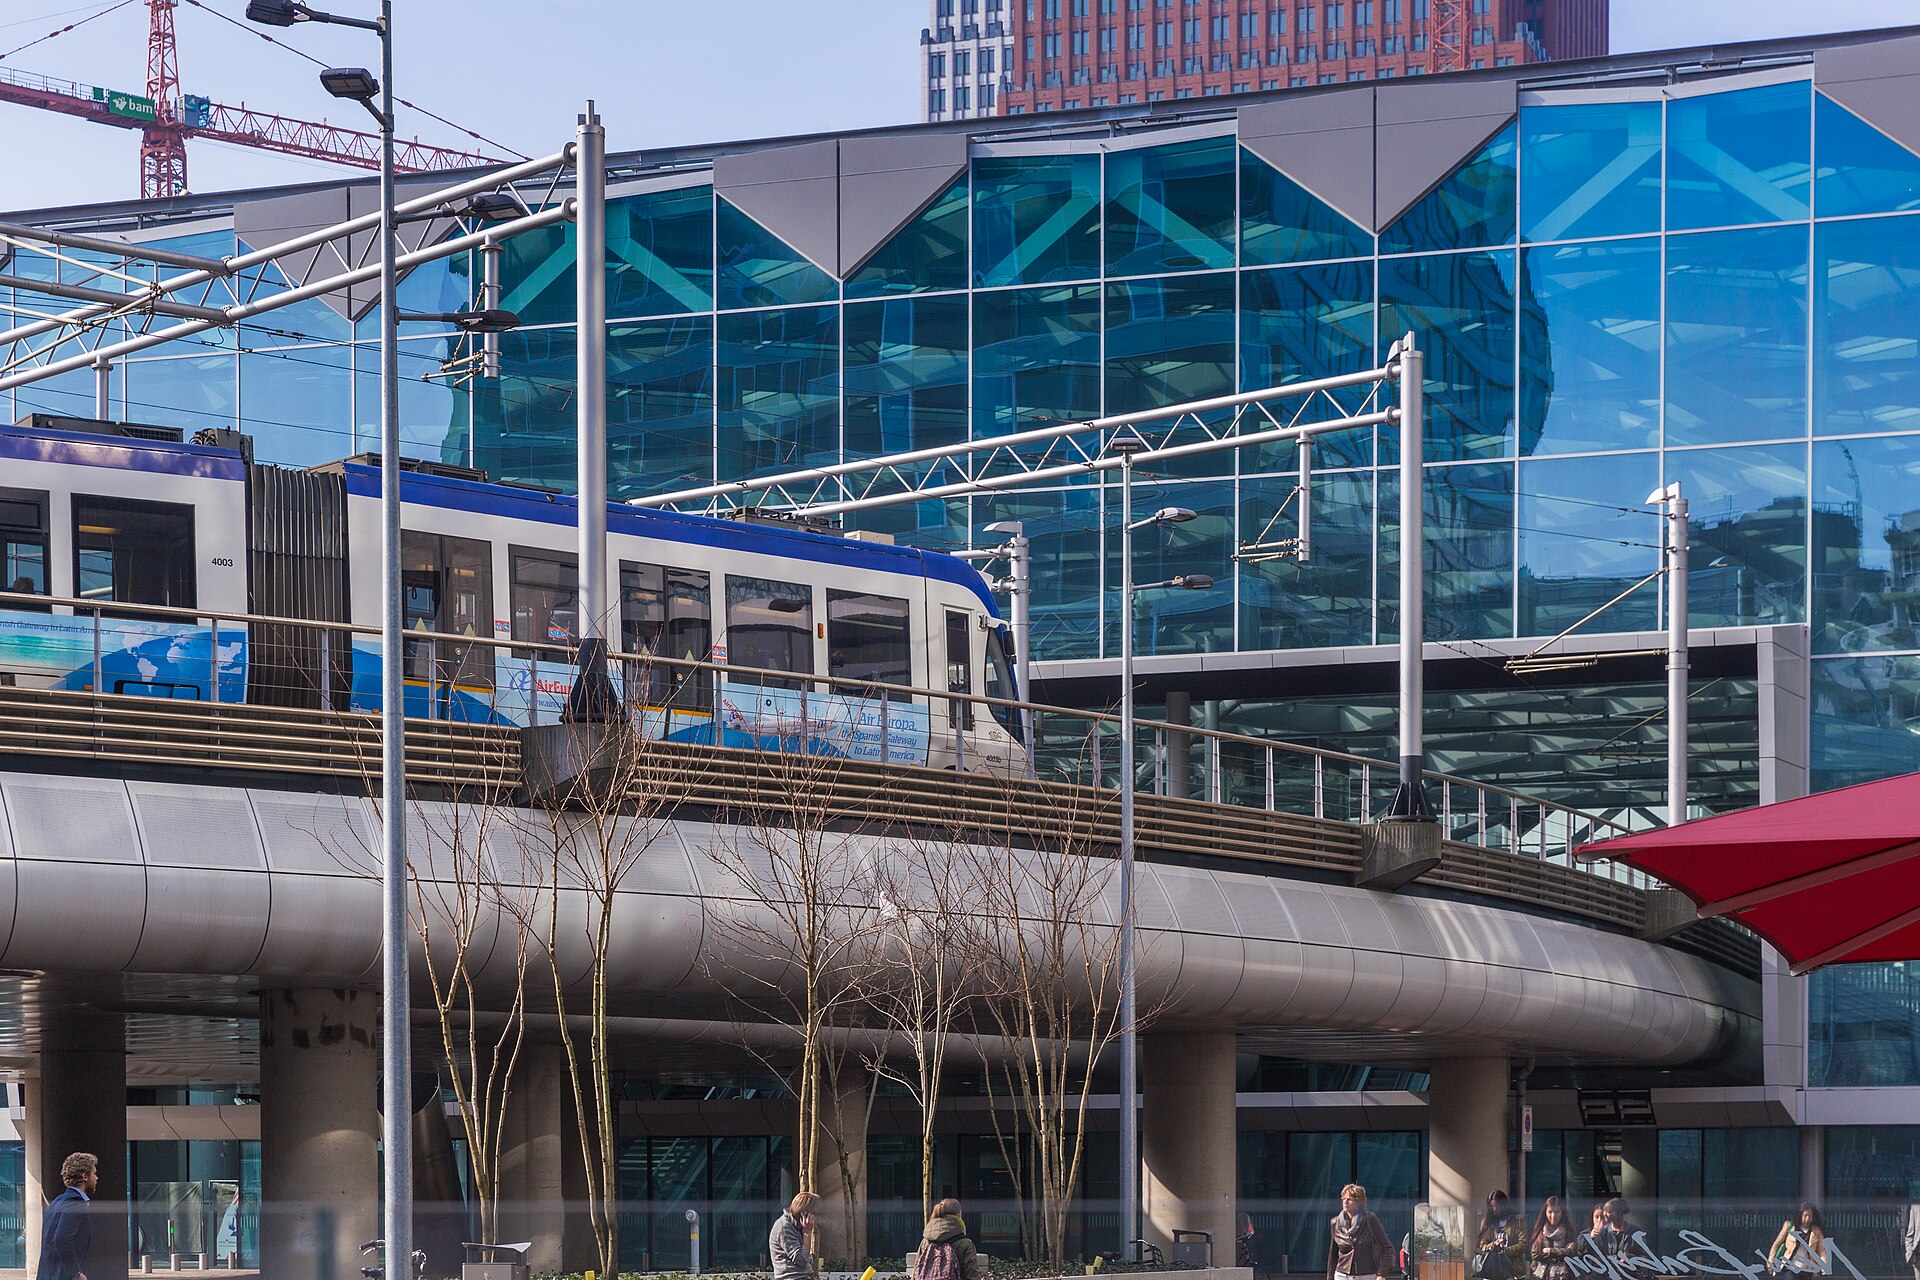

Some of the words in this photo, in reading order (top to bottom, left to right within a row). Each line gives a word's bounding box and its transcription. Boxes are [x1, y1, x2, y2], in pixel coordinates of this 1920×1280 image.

[129, 98, 153, 114] bam
[211, 557, 234, 567] 4003
[859, 712, 876, 725] Air
[854, 746, 863, 755] to
[888, 750, 915, 761] merica
